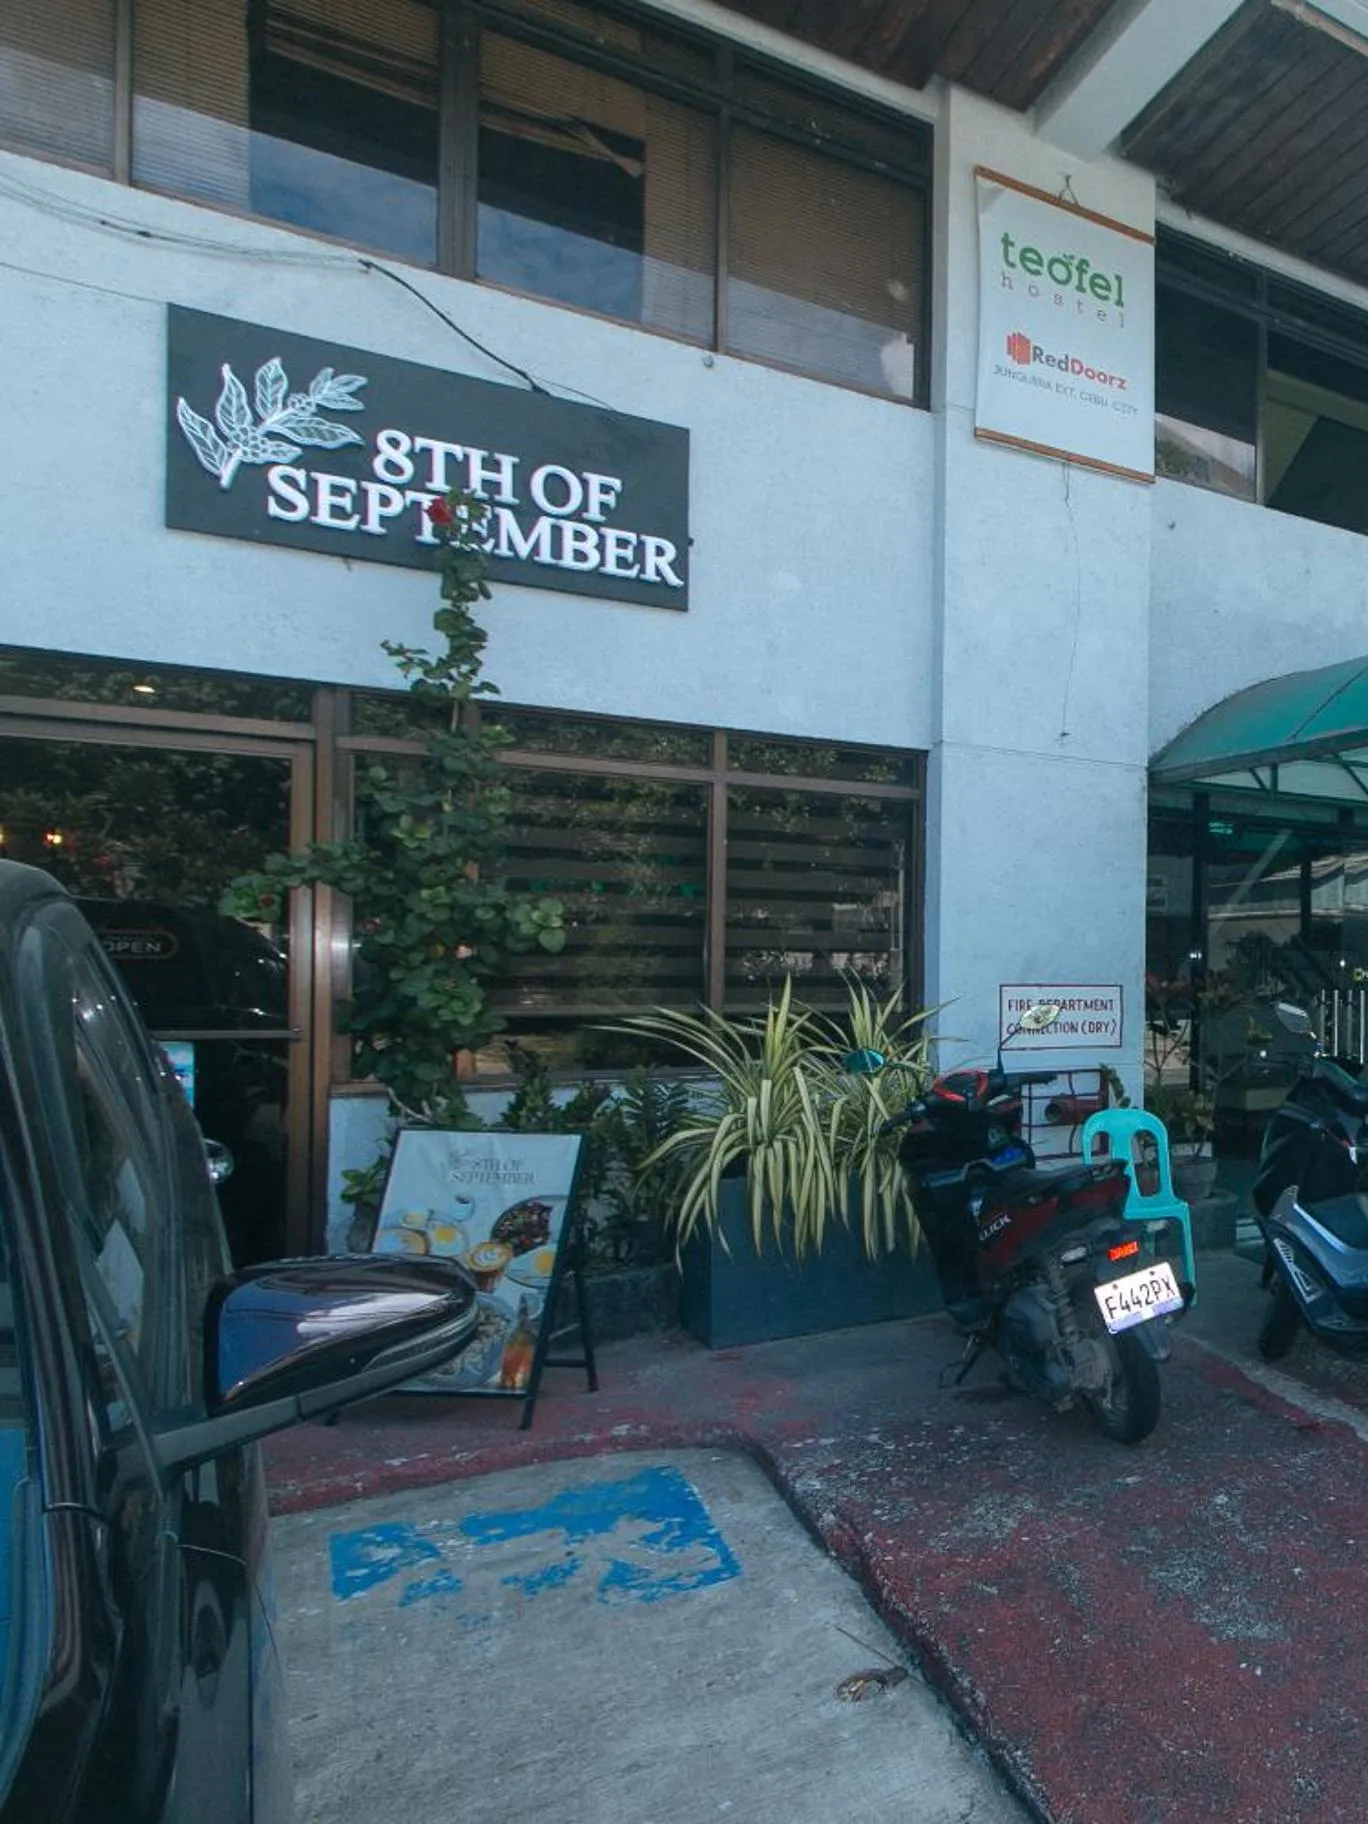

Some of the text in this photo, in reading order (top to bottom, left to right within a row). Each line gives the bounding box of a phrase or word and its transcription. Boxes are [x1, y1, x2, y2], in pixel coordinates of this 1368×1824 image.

[1000, 271, 1126, 329] hostel
[1031, 344, 1128, 391] RedDoorz
[371, 428, 623, 523] 8TH OF
[266, 465, 684, 588] SEPTEMBER
[1104, 1276, 1176, 1320] F442PX
